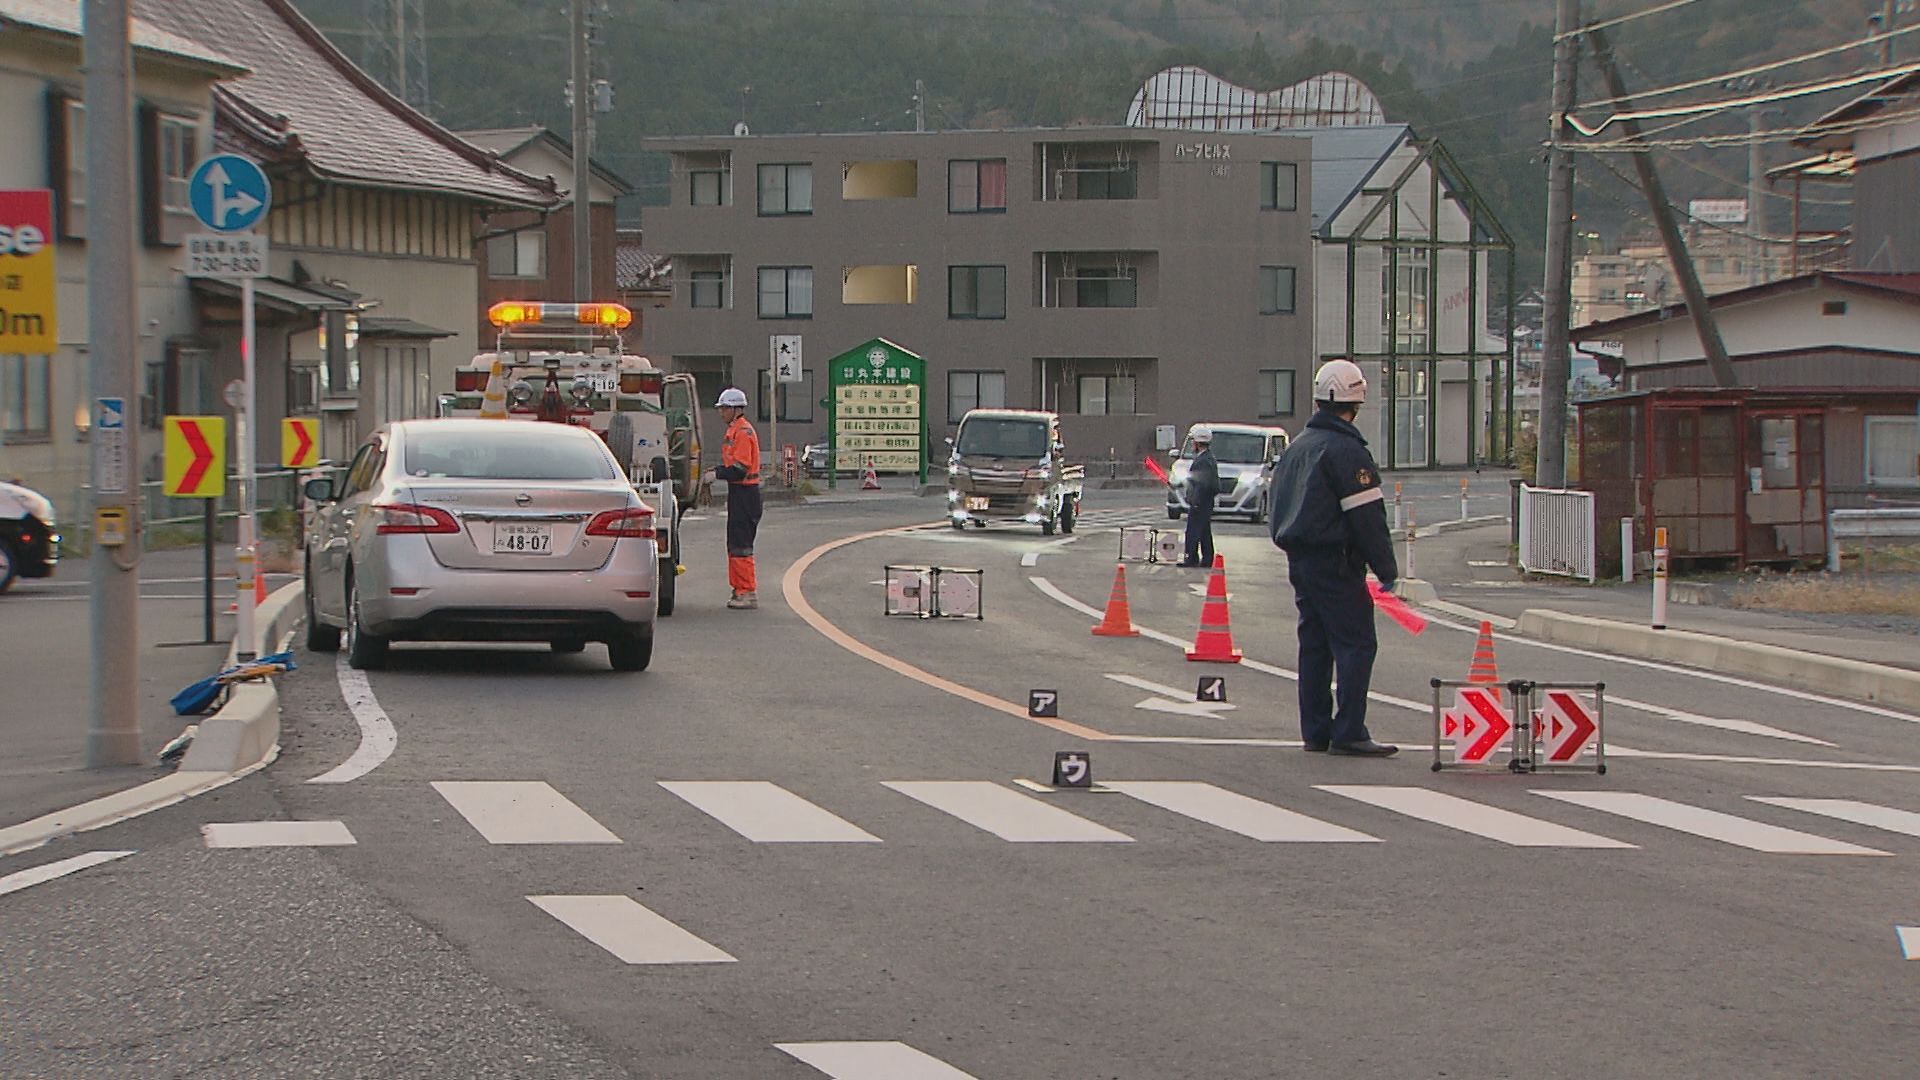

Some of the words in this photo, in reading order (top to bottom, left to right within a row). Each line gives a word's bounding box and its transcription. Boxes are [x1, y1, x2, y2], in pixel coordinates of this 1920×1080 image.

[507, 535, 549, 550] 48-07
[1205, 679, 1222, 699] イ
[1033, 692, 1055, 712] ア
[1061, 755, 1087, 783] ウ
